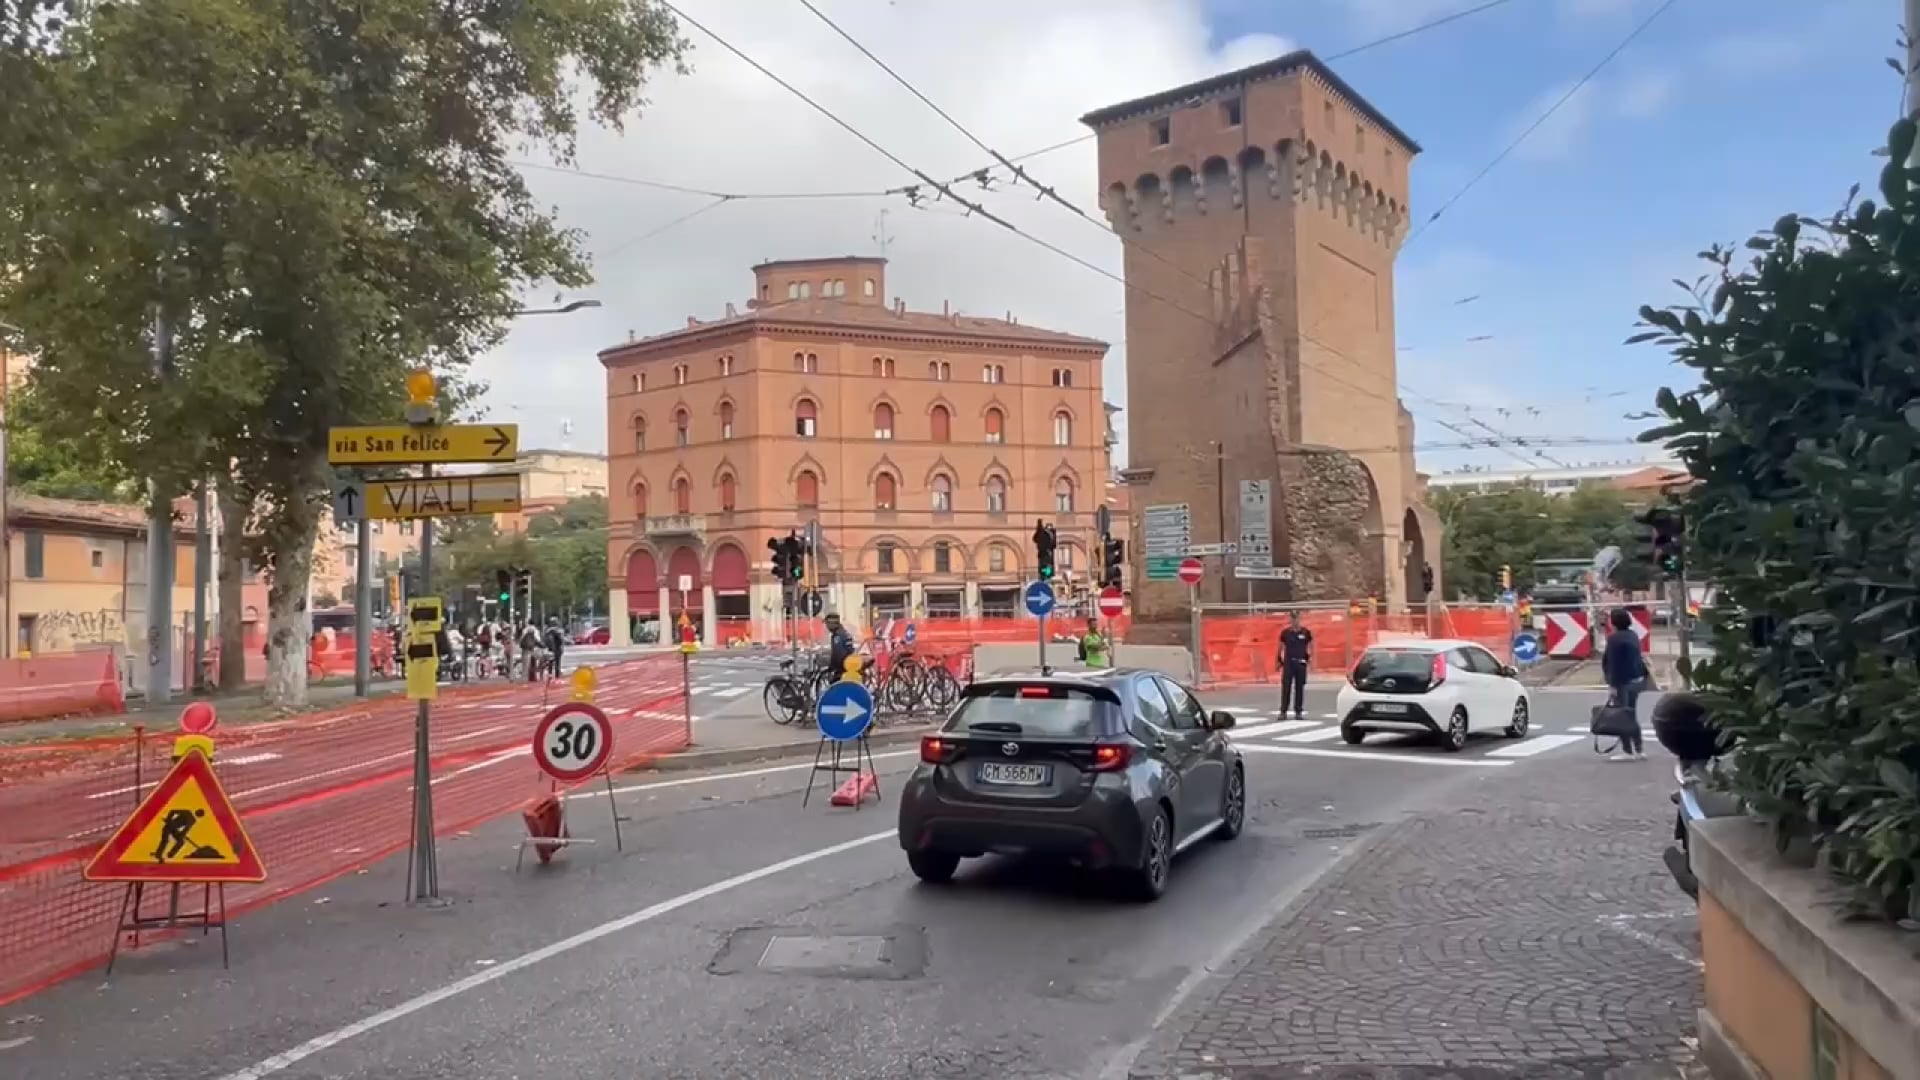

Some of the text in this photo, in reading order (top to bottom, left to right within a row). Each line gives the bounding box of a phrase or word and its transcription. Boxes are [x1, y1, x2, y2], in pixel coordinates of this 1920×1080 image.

[335, 433, 449, 453] via San Felice
[384, 479, 474, 514] VIALI
[551, 721, 595, 761] 30
